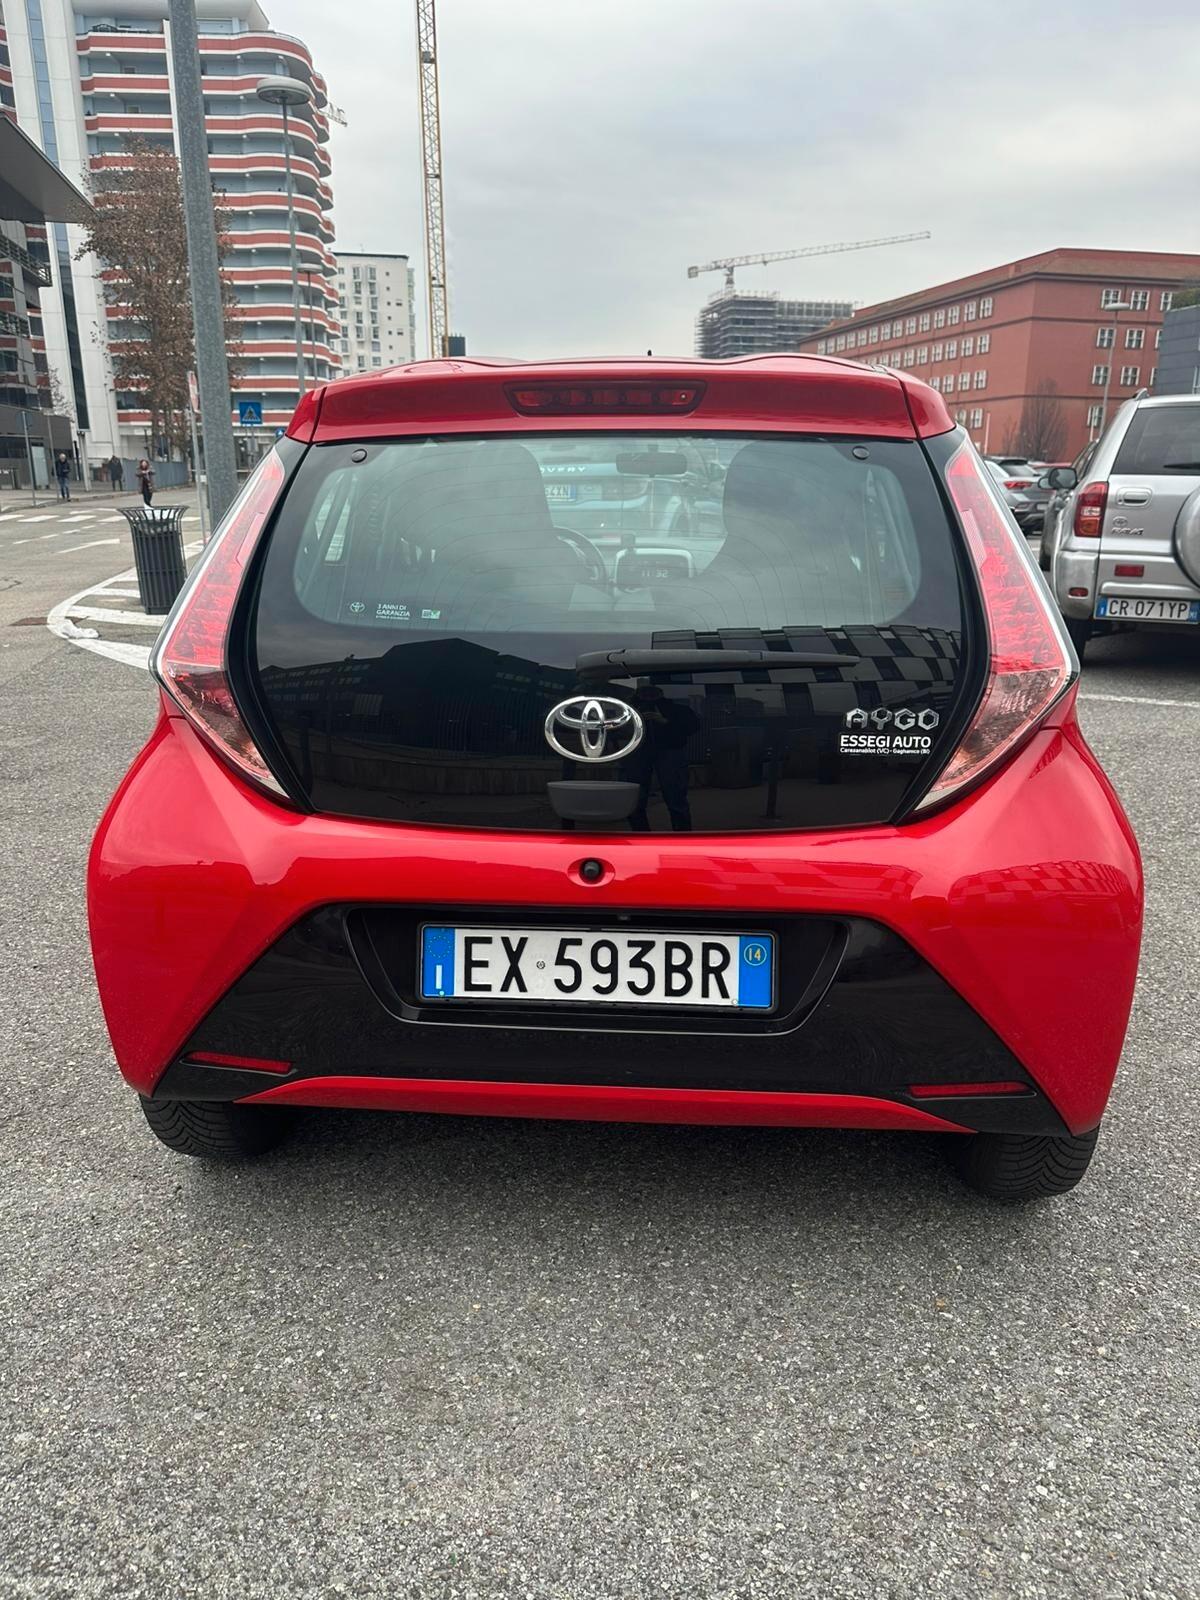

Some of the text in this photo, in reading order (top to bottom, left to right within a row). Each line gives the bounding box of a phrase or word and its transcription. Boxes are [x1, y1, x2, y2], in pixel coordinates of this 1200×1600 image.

[376, 609, 410, 617] GARANZIA
[1109, 600, 1188, 618] CR 071YP
[846, 707, 940, 731] AYGO
[840, 734, 932, 748] ESSEGI AUTO
[749, 947, 761, 961] 14
[464, 936, 731, 999] EX 593BR
